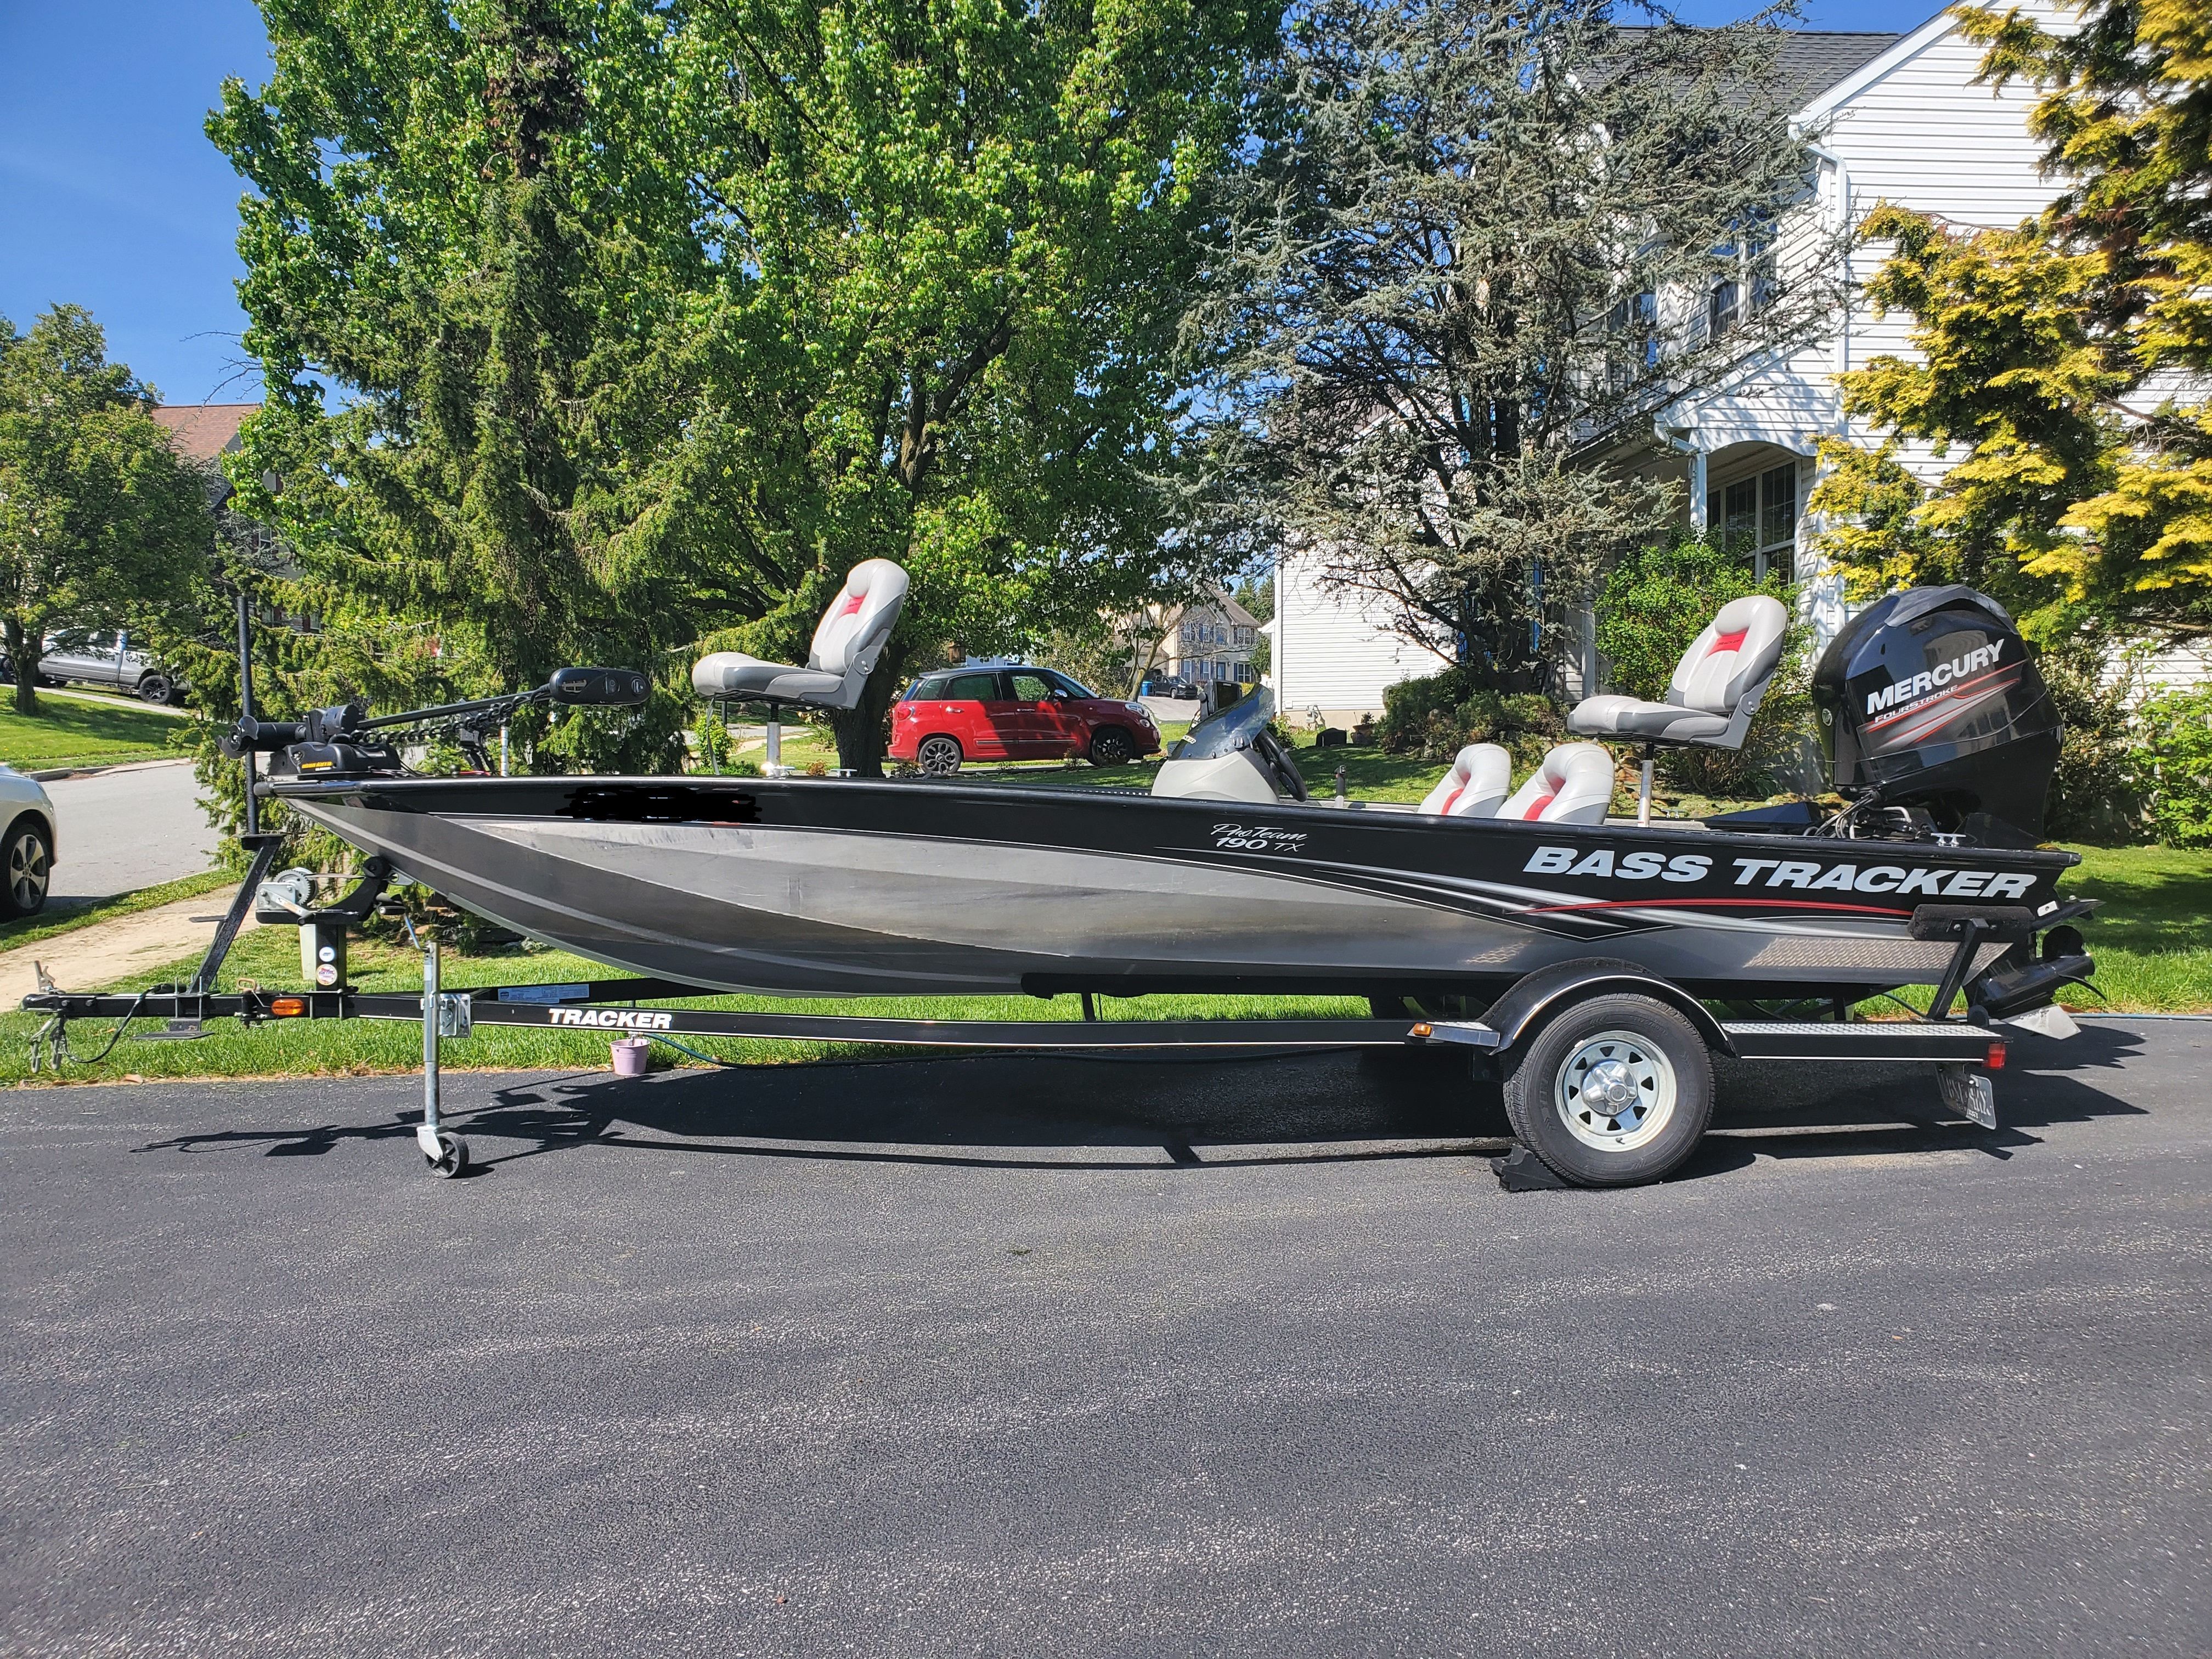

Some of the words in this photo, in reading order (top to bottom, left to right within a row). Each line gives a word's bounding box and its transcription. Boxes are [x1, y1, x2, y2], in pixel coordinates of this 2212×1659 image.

[1867, 639, 2005, 714] MERCURY
[1875, 685, 1959, 724] FOURSTROKE
[1216, 837, 1268, 850] 190
[1274, 843, 1305, 852] TX
[1523, 846, 1713, 882] BASS
[1732, 858, 2037, 899] TRACKER
[549, 1008, 673, 1029] TRACKER
